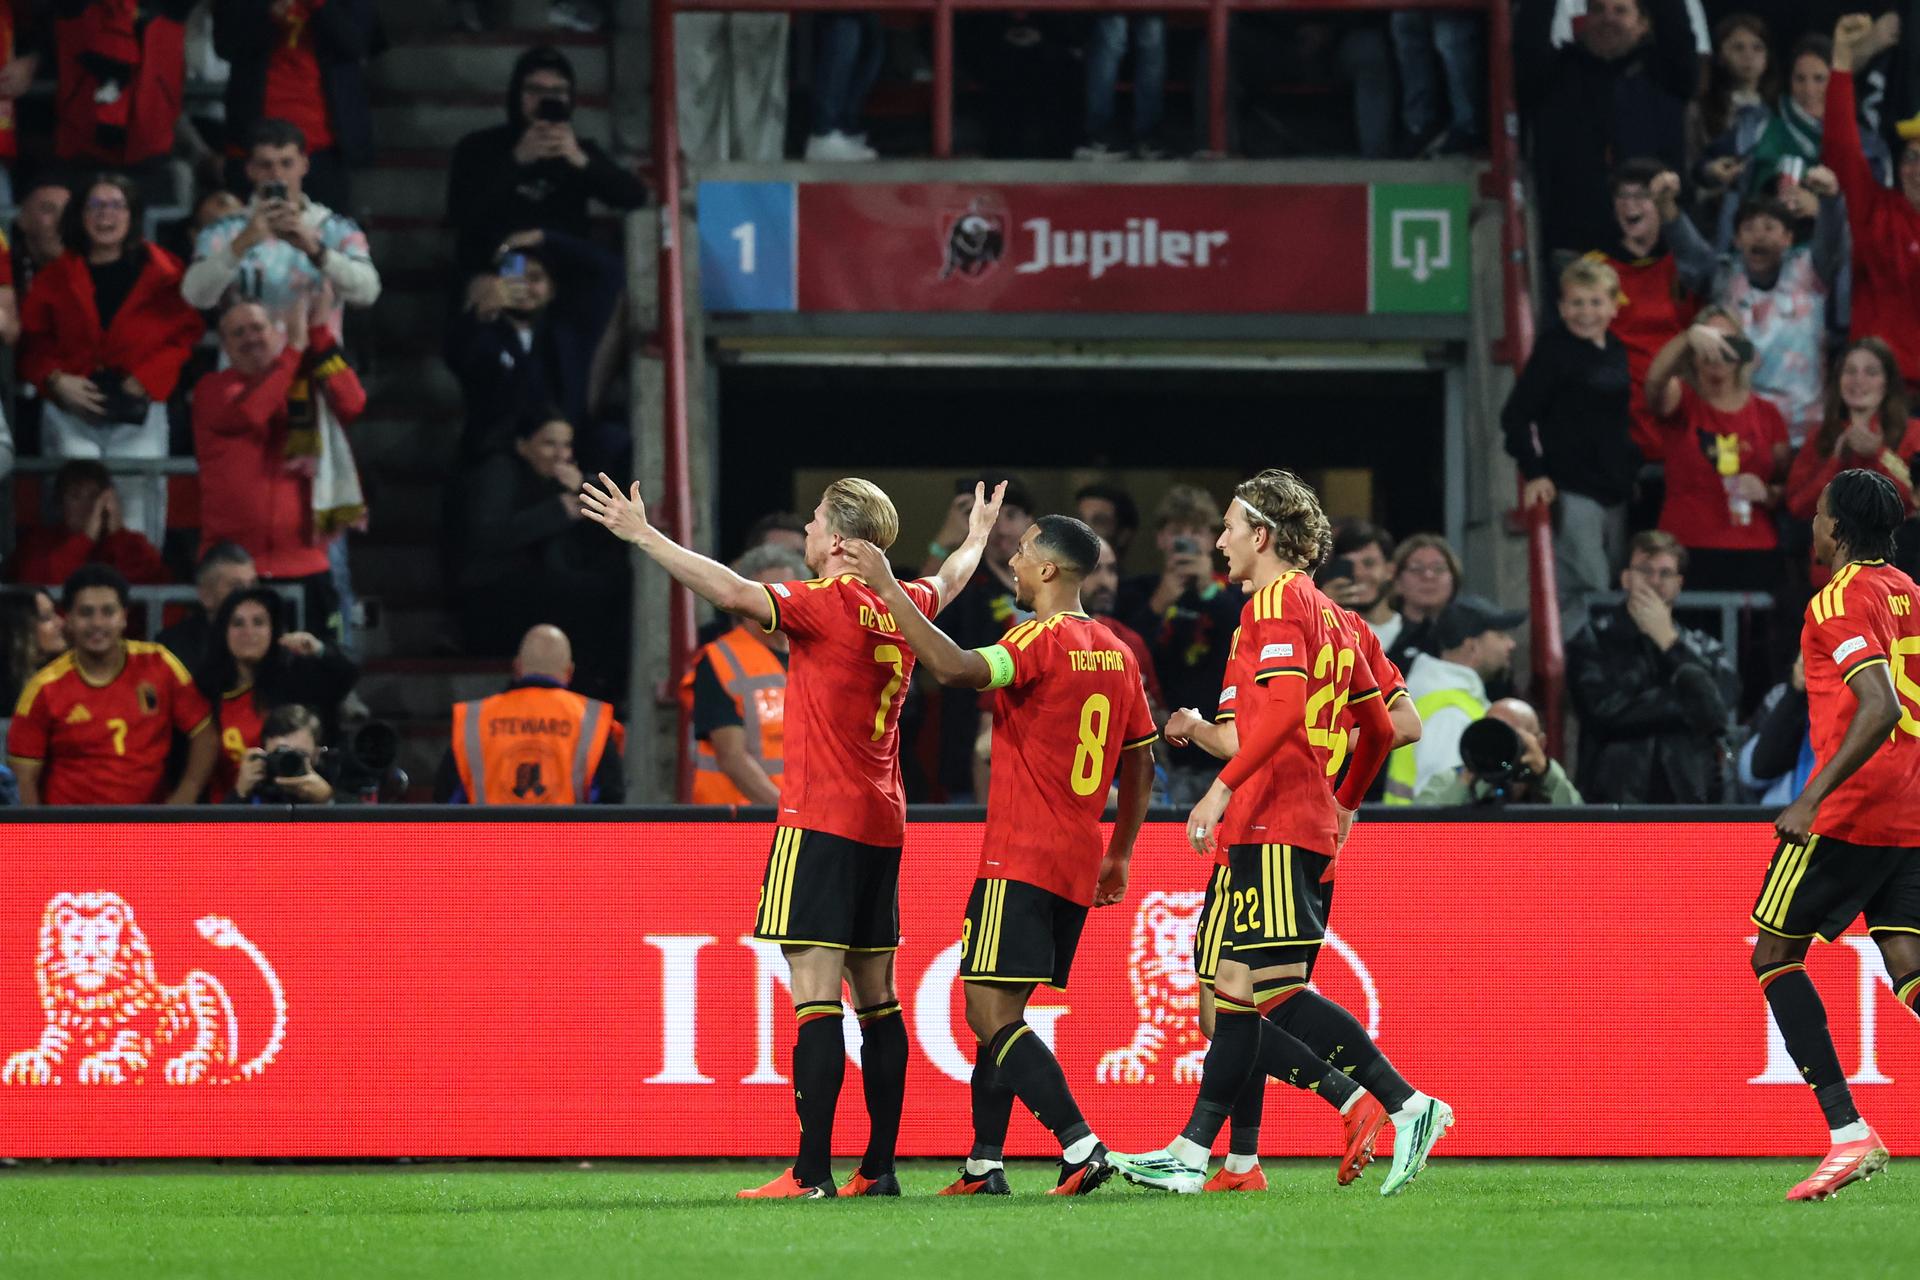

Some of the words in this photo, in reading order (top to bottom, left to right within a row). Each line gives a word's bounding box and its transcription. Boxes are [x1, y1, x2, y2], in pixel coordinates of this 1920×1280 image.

[731, 222, 756, 274] 1
[1016, 217, 1230, 280] Jupiler
[870, 644, 903, 742] 7
[1304, 643, 1356, 751] 22
[106, 718, 128, 756] 7
[489, 717, 572, 737] STEWARD
[1070, 693, 1111, 796] 8
[1233, 886, 1261, 934] 22
